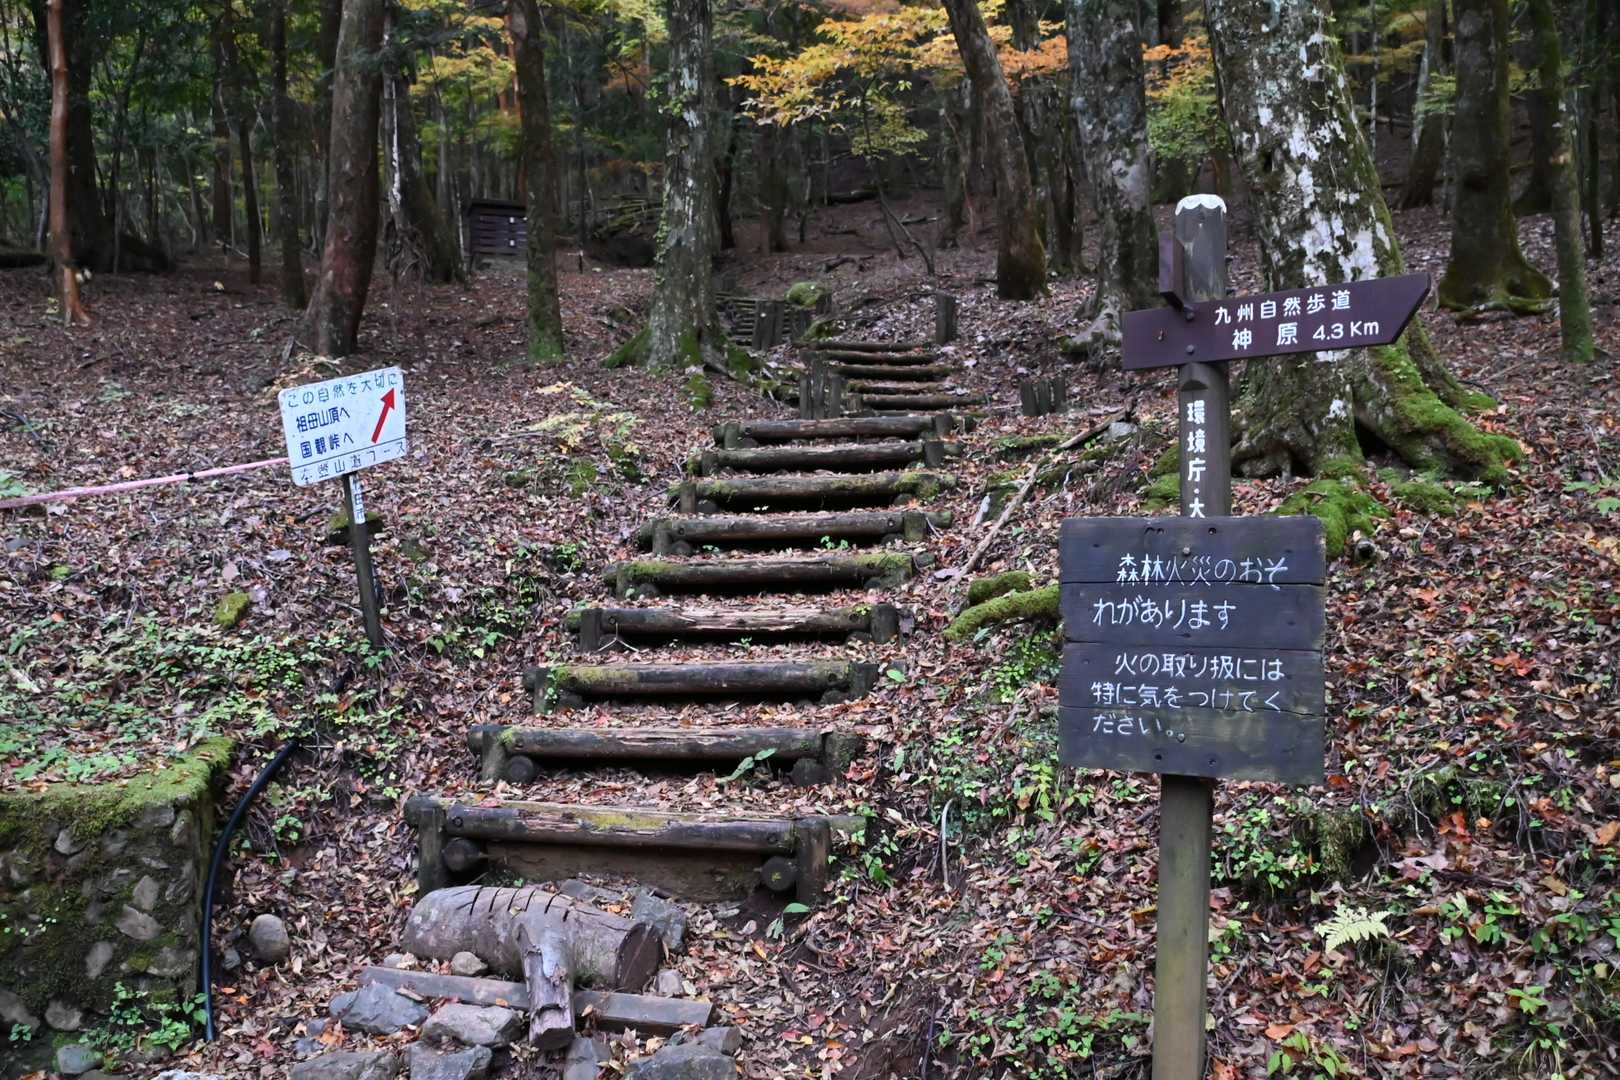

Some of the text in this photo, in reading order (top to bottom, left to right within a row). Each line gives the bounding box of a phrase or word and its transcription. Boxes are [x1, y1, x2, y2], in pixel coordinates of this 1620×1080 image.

[1213, 289, 1351, 326] 九州自然歩道
[287, 372, 398, 408] この自然を大切に
[295, 406, 351, 433] 祖母山頂へ
[299, 432, 355, 459] 国観峠へ
[1116, 552, 1289, 591] 森林火災のおそ
[1092, 594, 1237, 630] れがあります
[1114, 652, 1285, 681] 火の取り扱には
[1090, 681, 1282, 713] 特に気をつけてく
